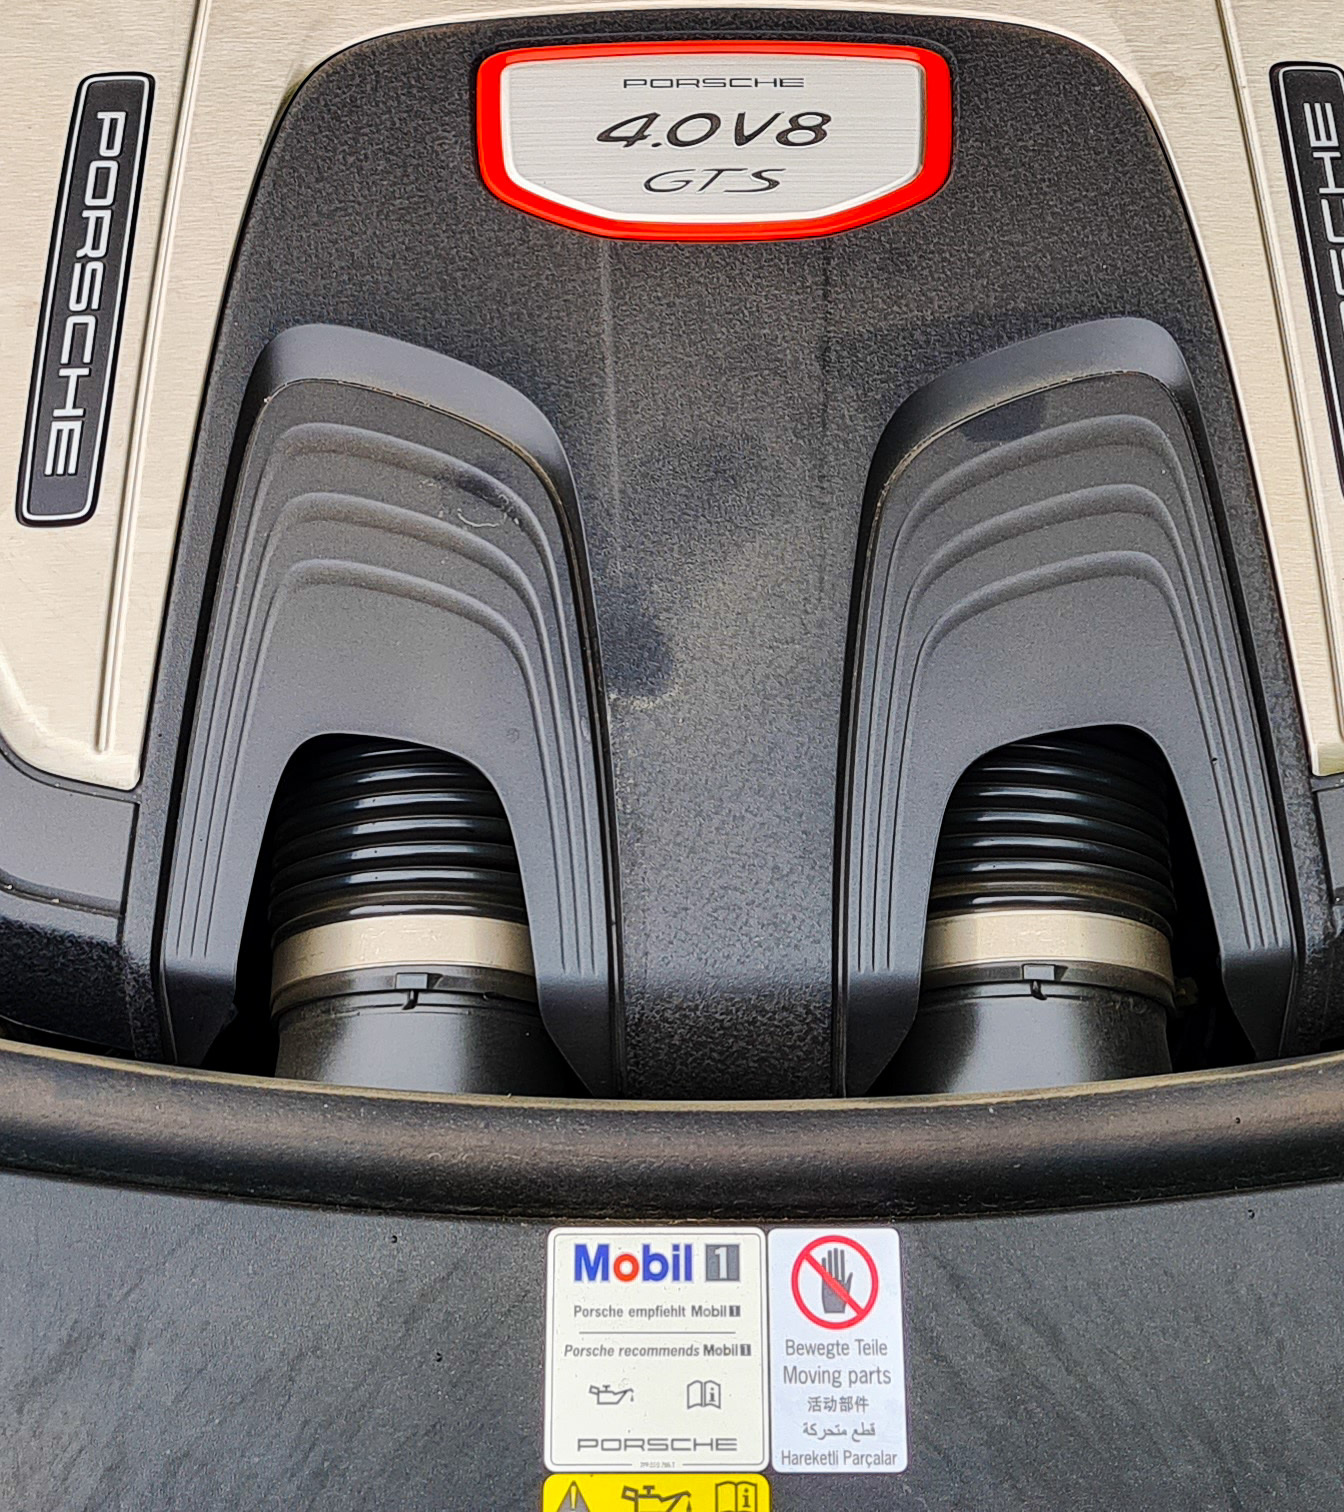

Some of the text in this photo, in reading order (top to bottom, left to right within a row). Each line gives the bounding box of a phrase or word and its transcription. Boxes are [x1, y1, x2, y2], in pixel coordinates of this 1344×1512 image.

[623, 77, 805, 89] PORSCHE
[643, 168, 786, 194] GTS
[43, 111, 126, 477] PORSCHE
[574, 1243, 693, 1283] Mobil
[574, 1304, 623, 1318] Porsche
[628, 1304, 686, 1320] empfiehlt
[564, 1344, 615, 1357] Porsche
[618, 1344, 700, 1357] recommends
[785, 1338, 888, 1360] Bewegte Teile
[783, 1365, 892, 1389] Moving parts
[807, 1395, 870, 1413] 活动部件
[802, 1421, 876, 1442] قطع متحركة
[577, 1437, 738, 1452] PORSCHE
[781, 1449, 898, 1468] Hareketli Parçalar
